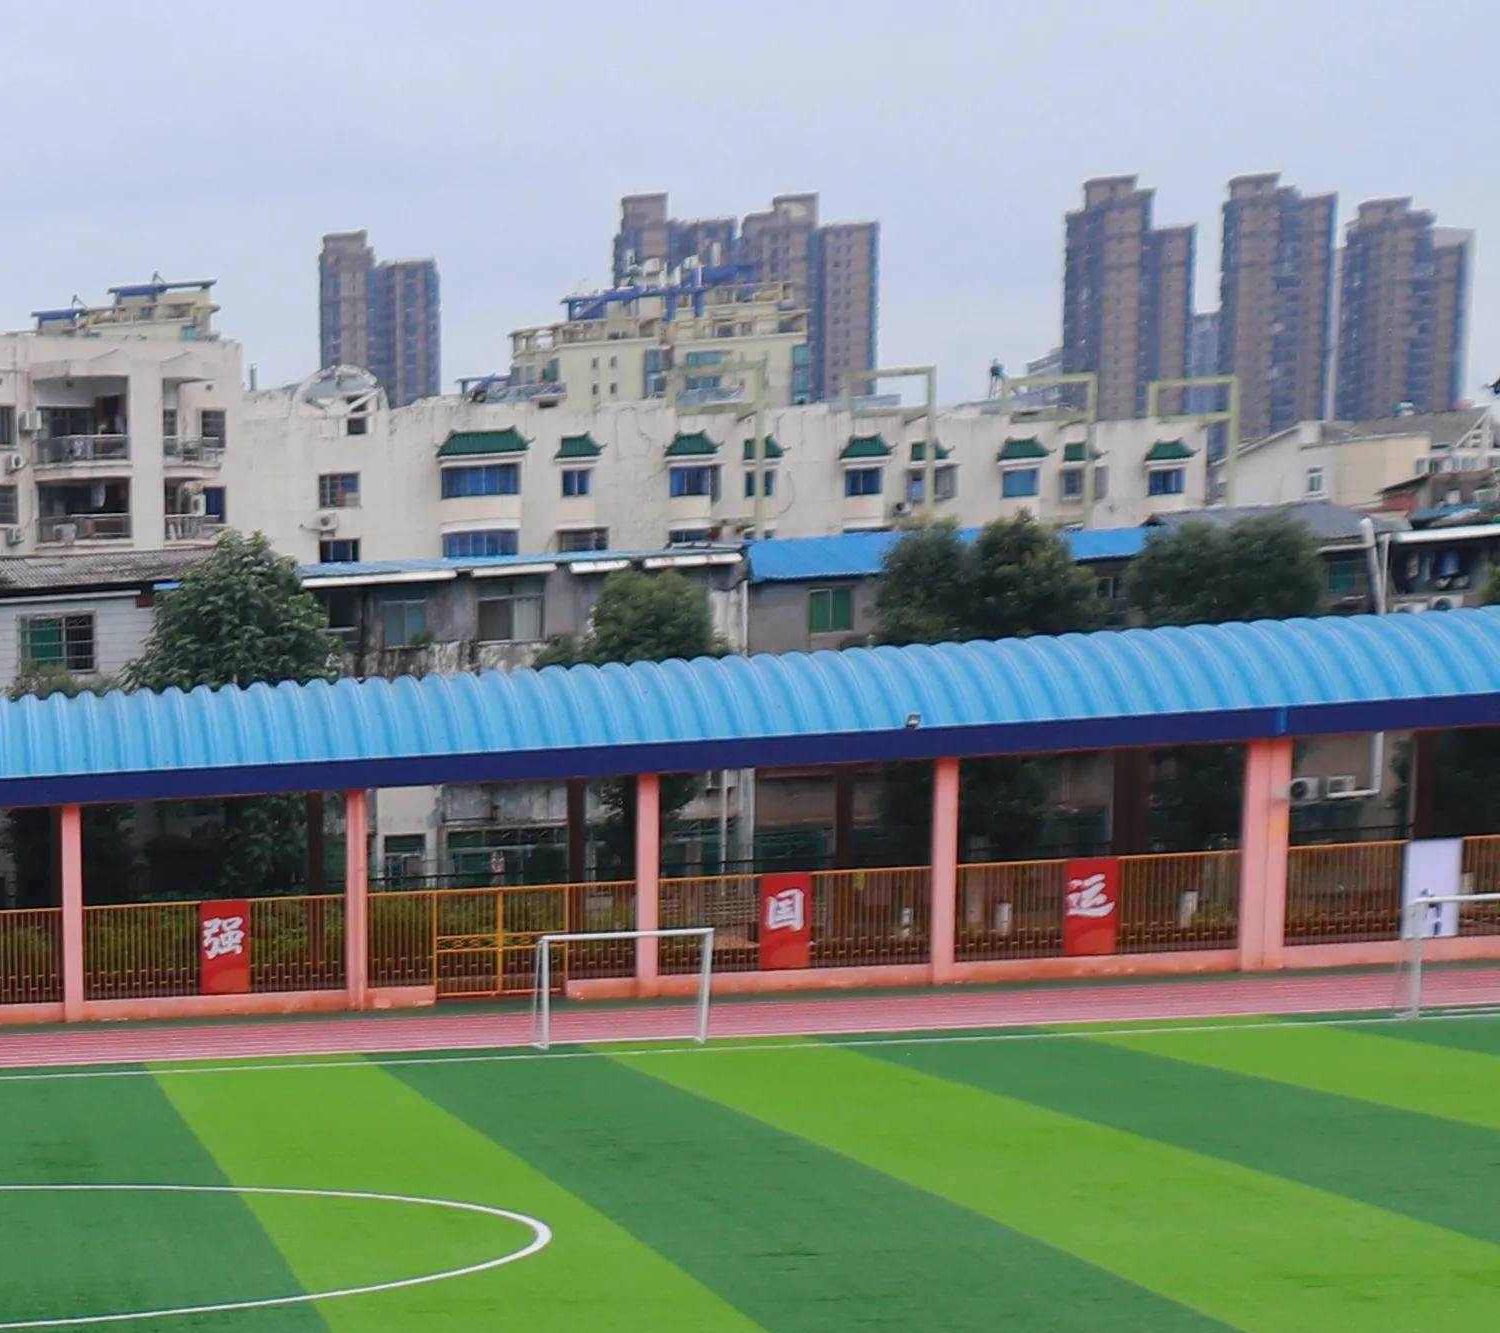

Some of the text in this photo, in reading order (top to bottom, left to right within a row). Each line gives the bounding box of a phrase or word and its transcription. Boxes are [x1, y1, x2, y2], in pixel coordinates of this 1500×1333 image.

[766, 888, 805, 932] 国
[1066, 873, 1116, 917] 运
[203, 916, 245, 960] 强
